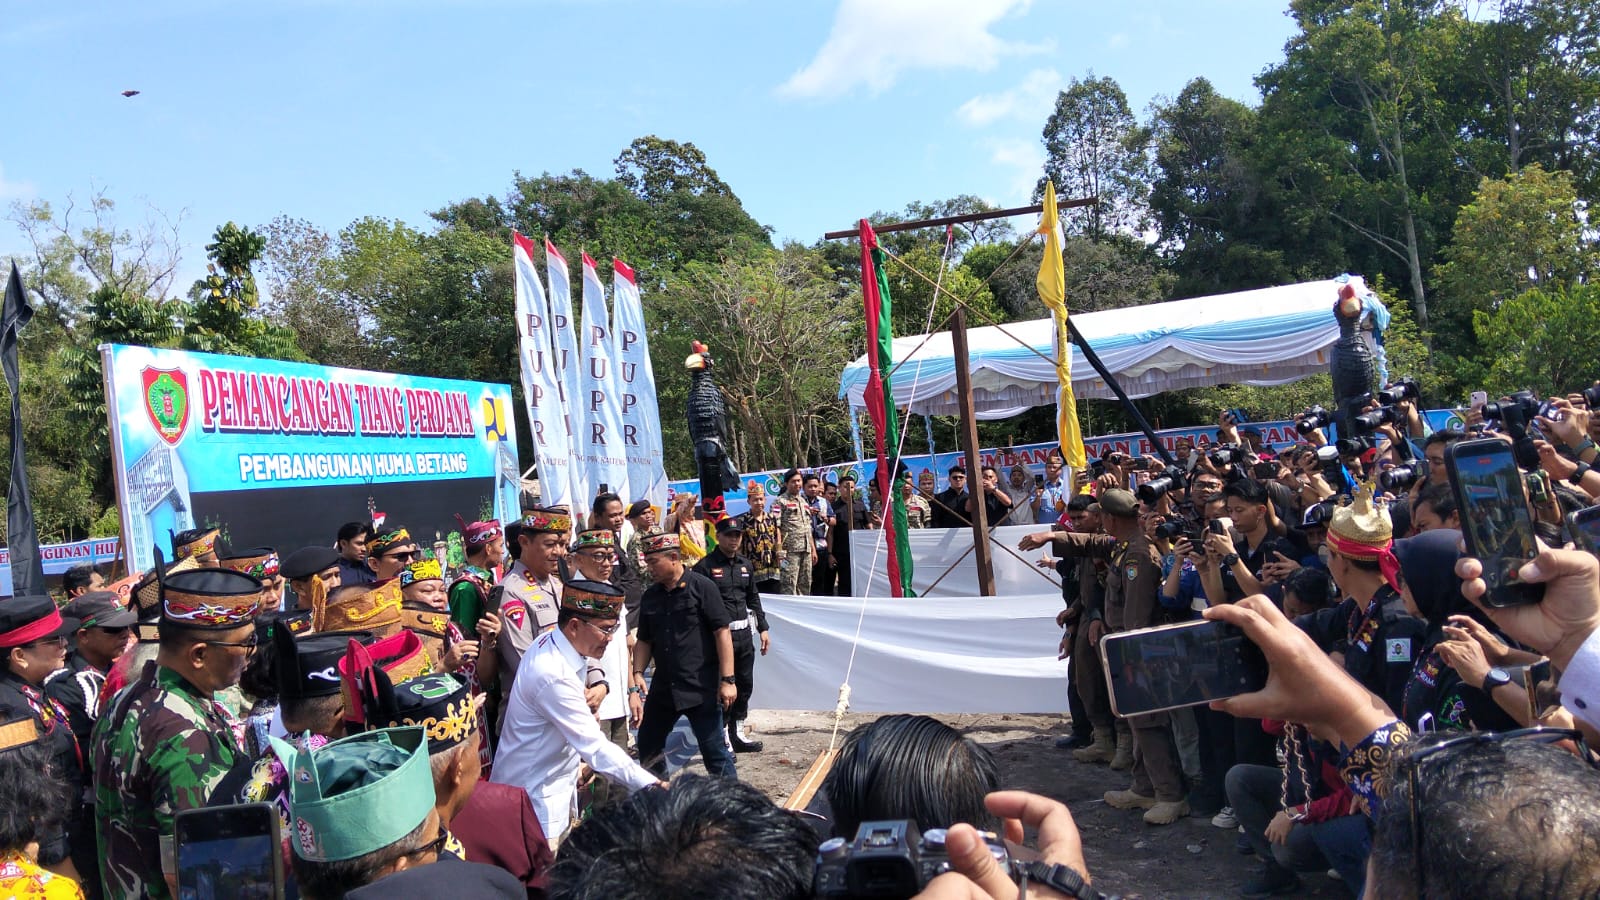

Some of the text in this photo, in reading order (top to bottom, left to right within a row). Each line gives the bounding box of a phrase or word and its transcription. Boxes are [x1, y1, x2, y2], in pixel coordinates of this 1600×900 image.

[199, 368, 476, 438] PEMANCANGAN TIANG PERDANA
[526, 314, 546, 445] PUPR
[590, 326, 607, 445] PUPR
[621, 330, 639, 446] PUPR
[239, 452, 468, 482] PEMBANGUNAN HUMA BETANG
